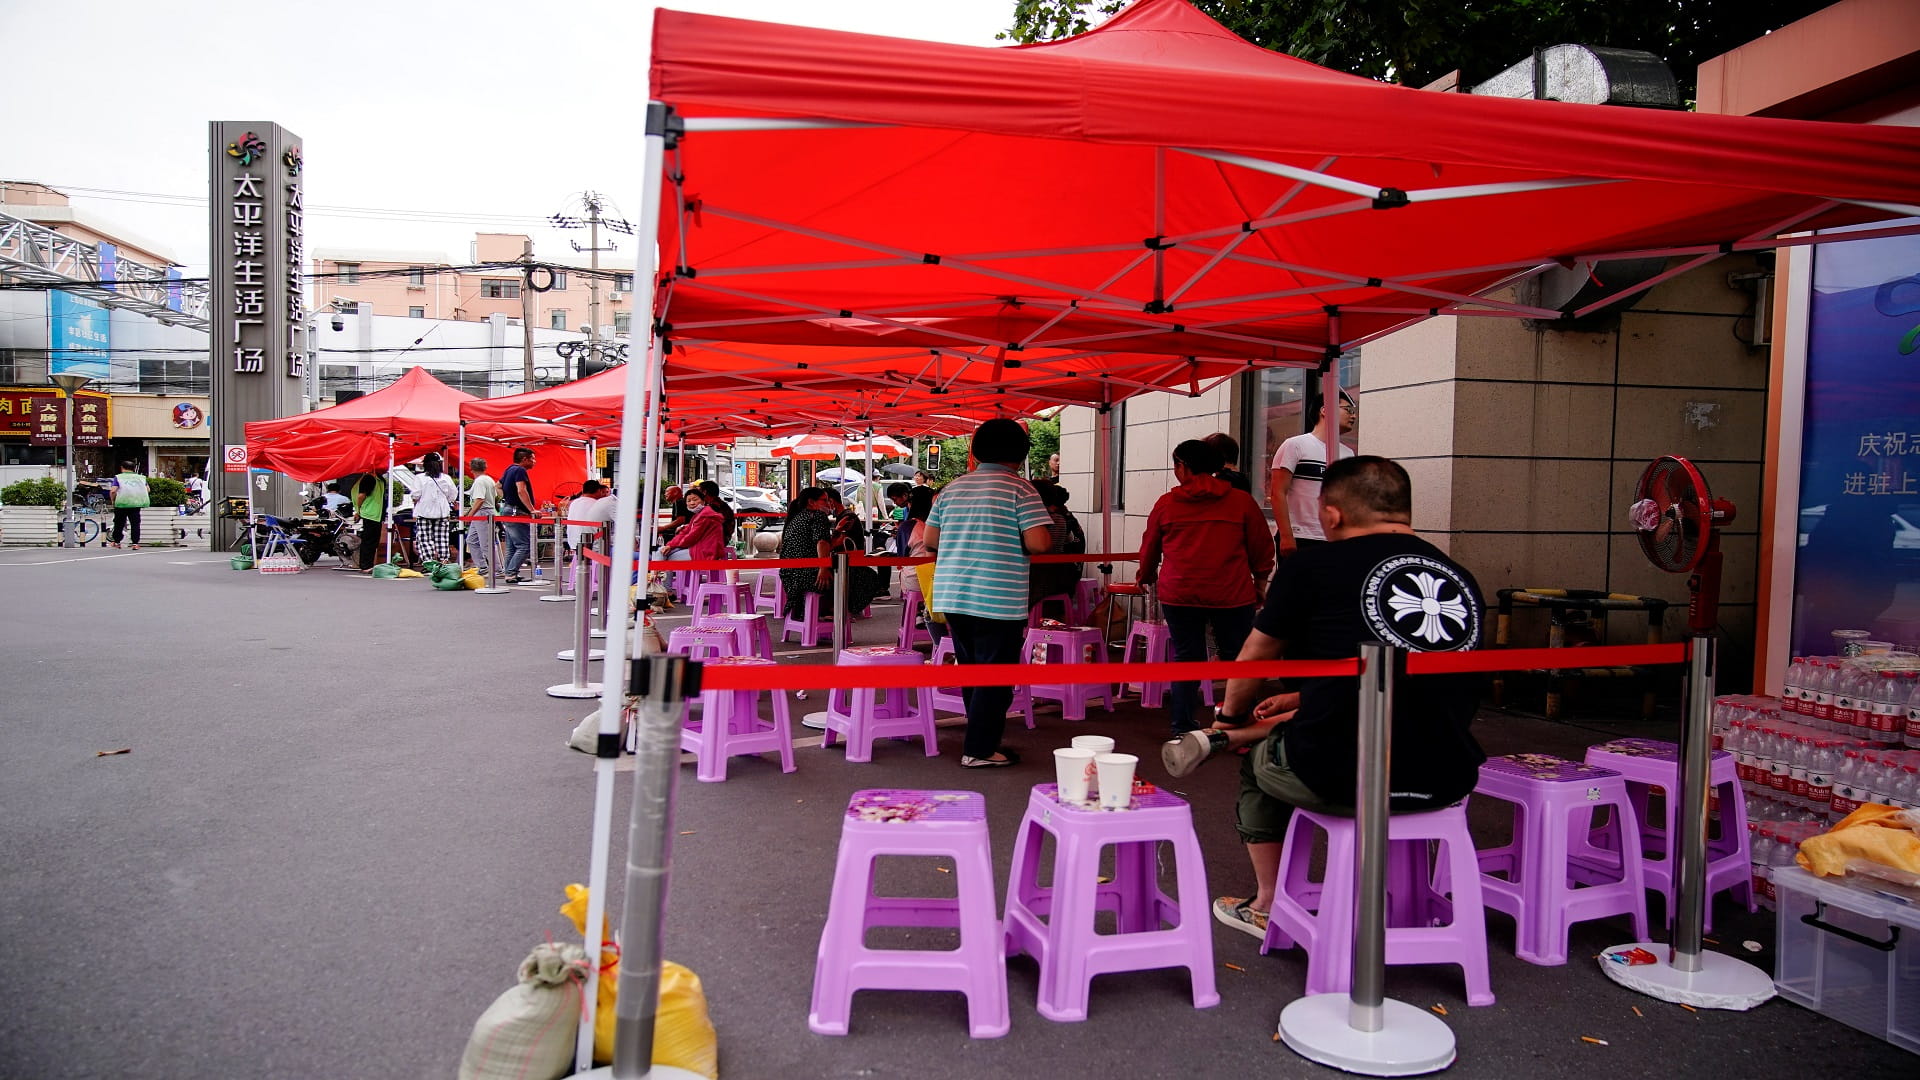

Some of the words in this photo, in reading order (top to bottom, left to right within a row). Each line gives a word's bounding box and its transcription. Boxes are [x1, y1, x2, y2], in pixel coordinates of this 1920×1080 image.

[233, 173, 264, 373] 太平洋生活广场
[289, 184, 304, 378] 太平洋生活广场
[40, 403, 58, 433] 大肠面
[80, 403, 98, 433] 黄鱼面
[1842, 471, 1918, 496] 进驻上
